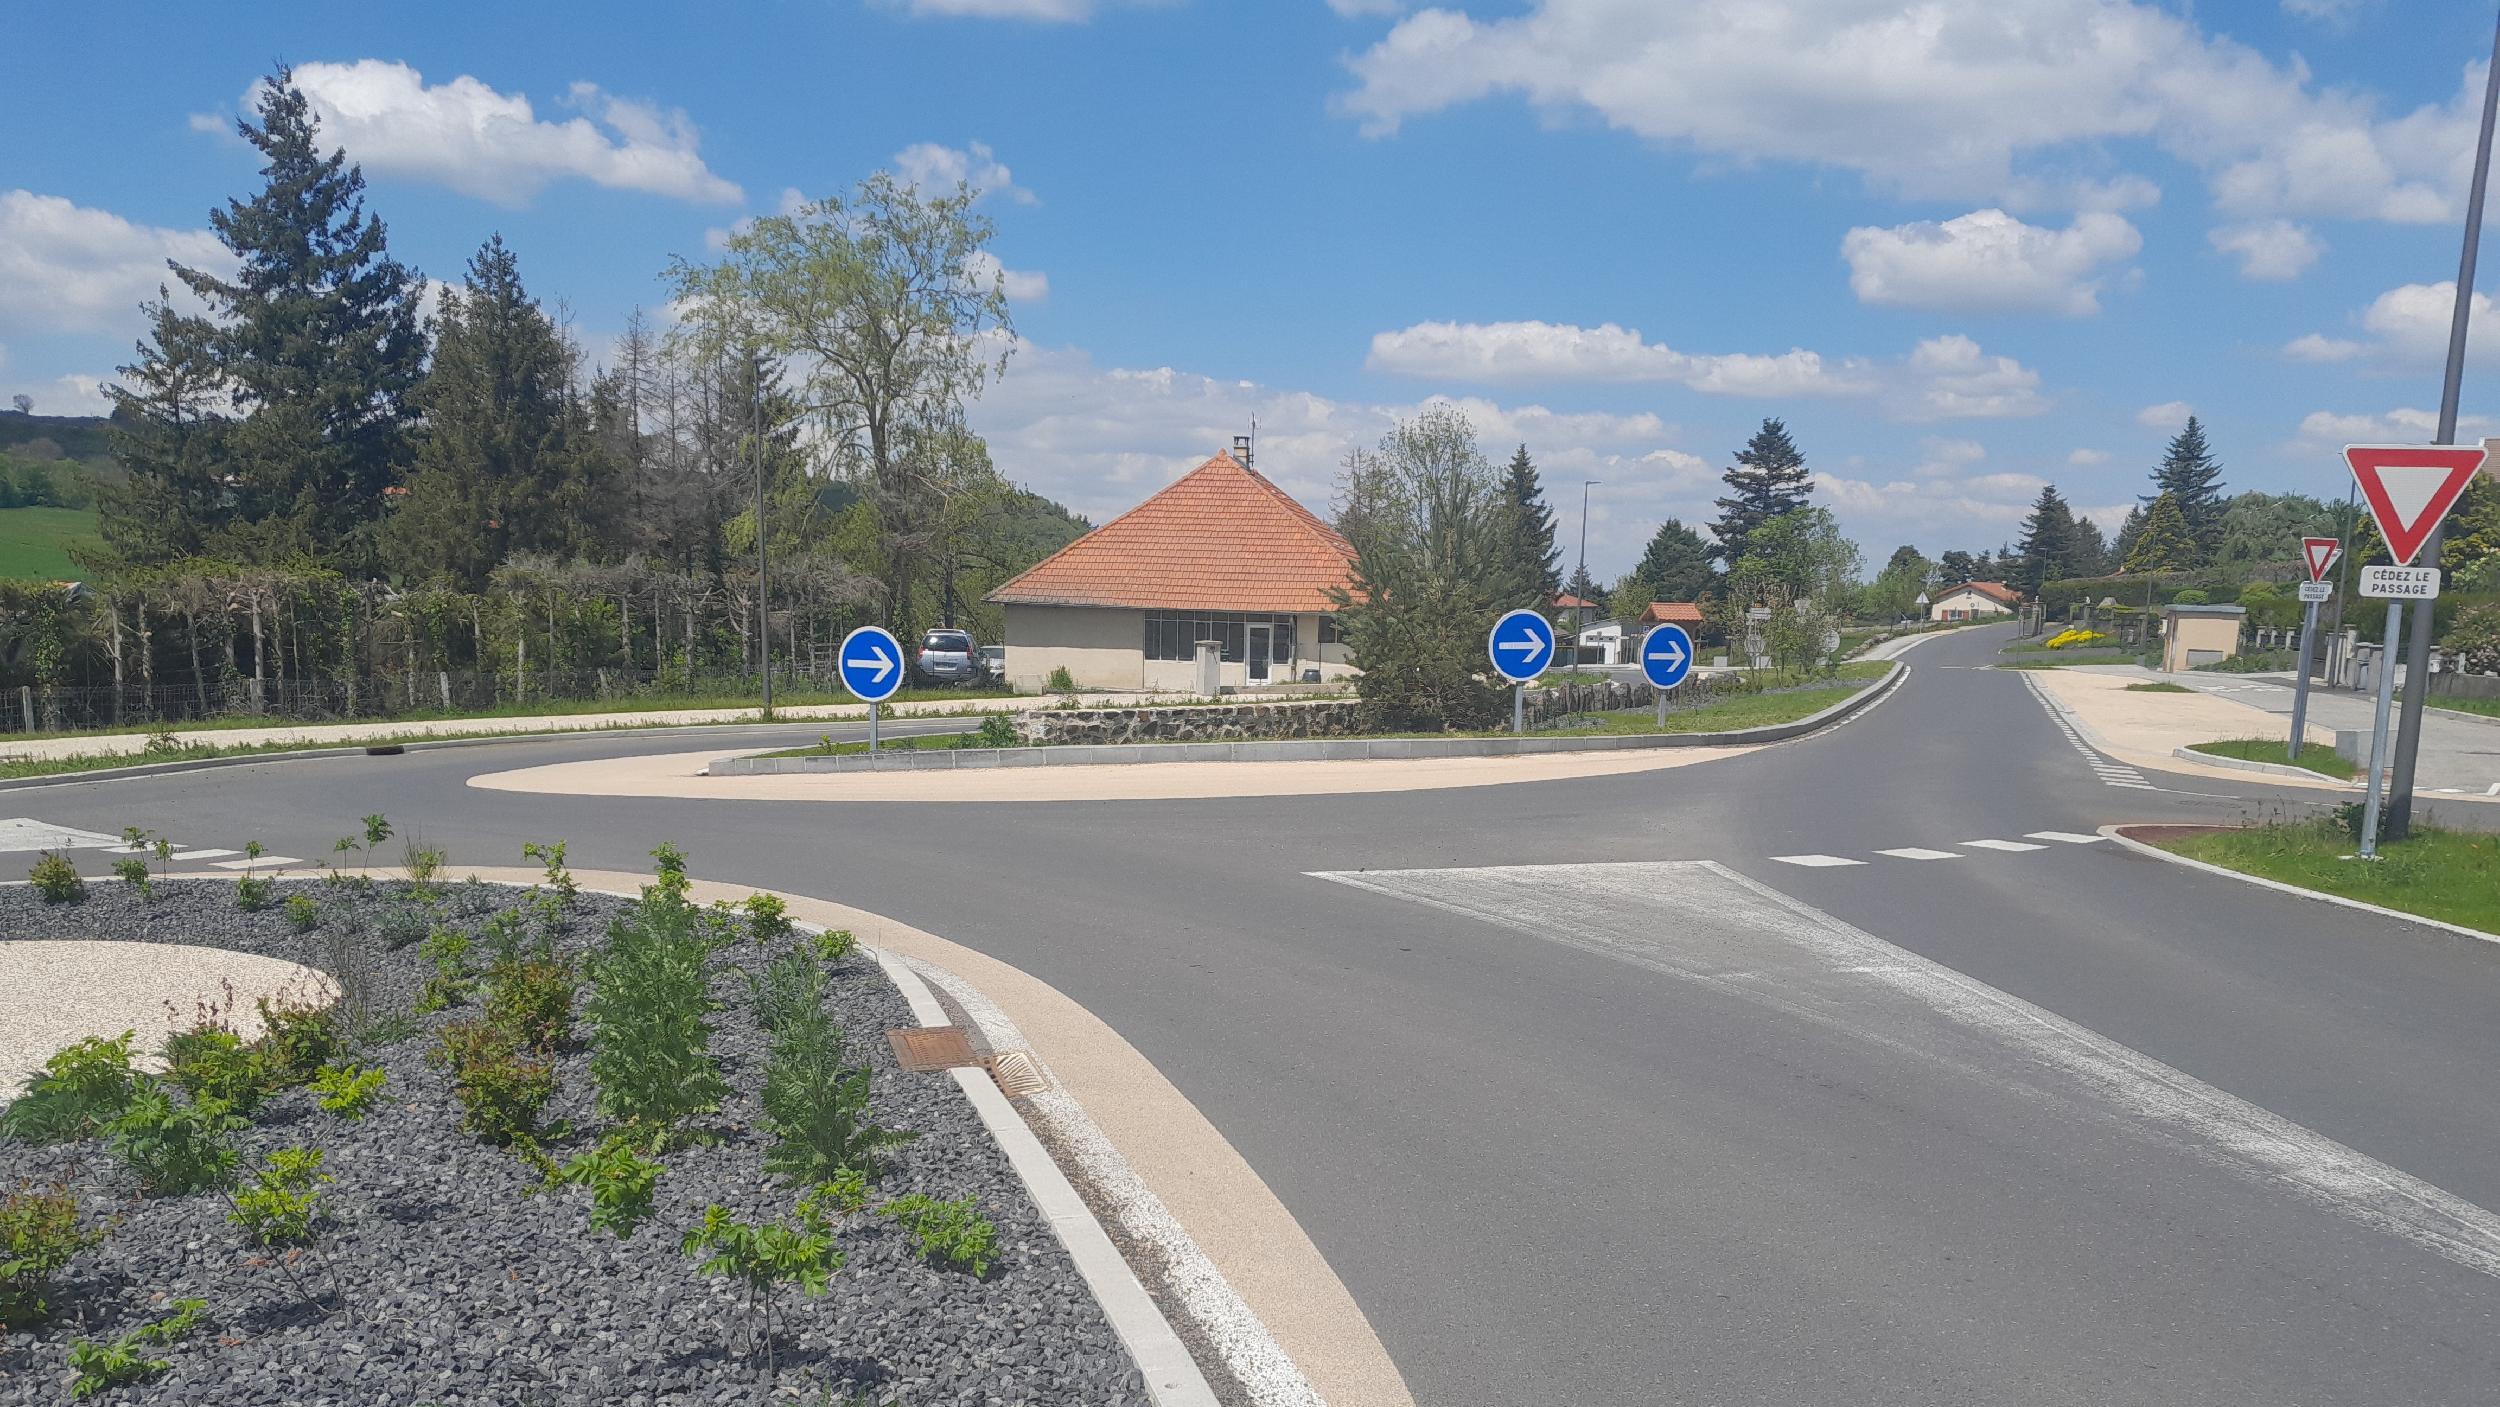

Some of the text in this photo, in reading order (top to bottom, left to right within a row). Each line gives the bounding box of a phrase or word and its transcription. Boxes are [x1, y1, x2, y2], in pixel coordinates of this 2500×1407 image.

[2373, 569, 2430, 582] CÉDEZ LE
[2371, 583, 2428, 595] PASSAGE
